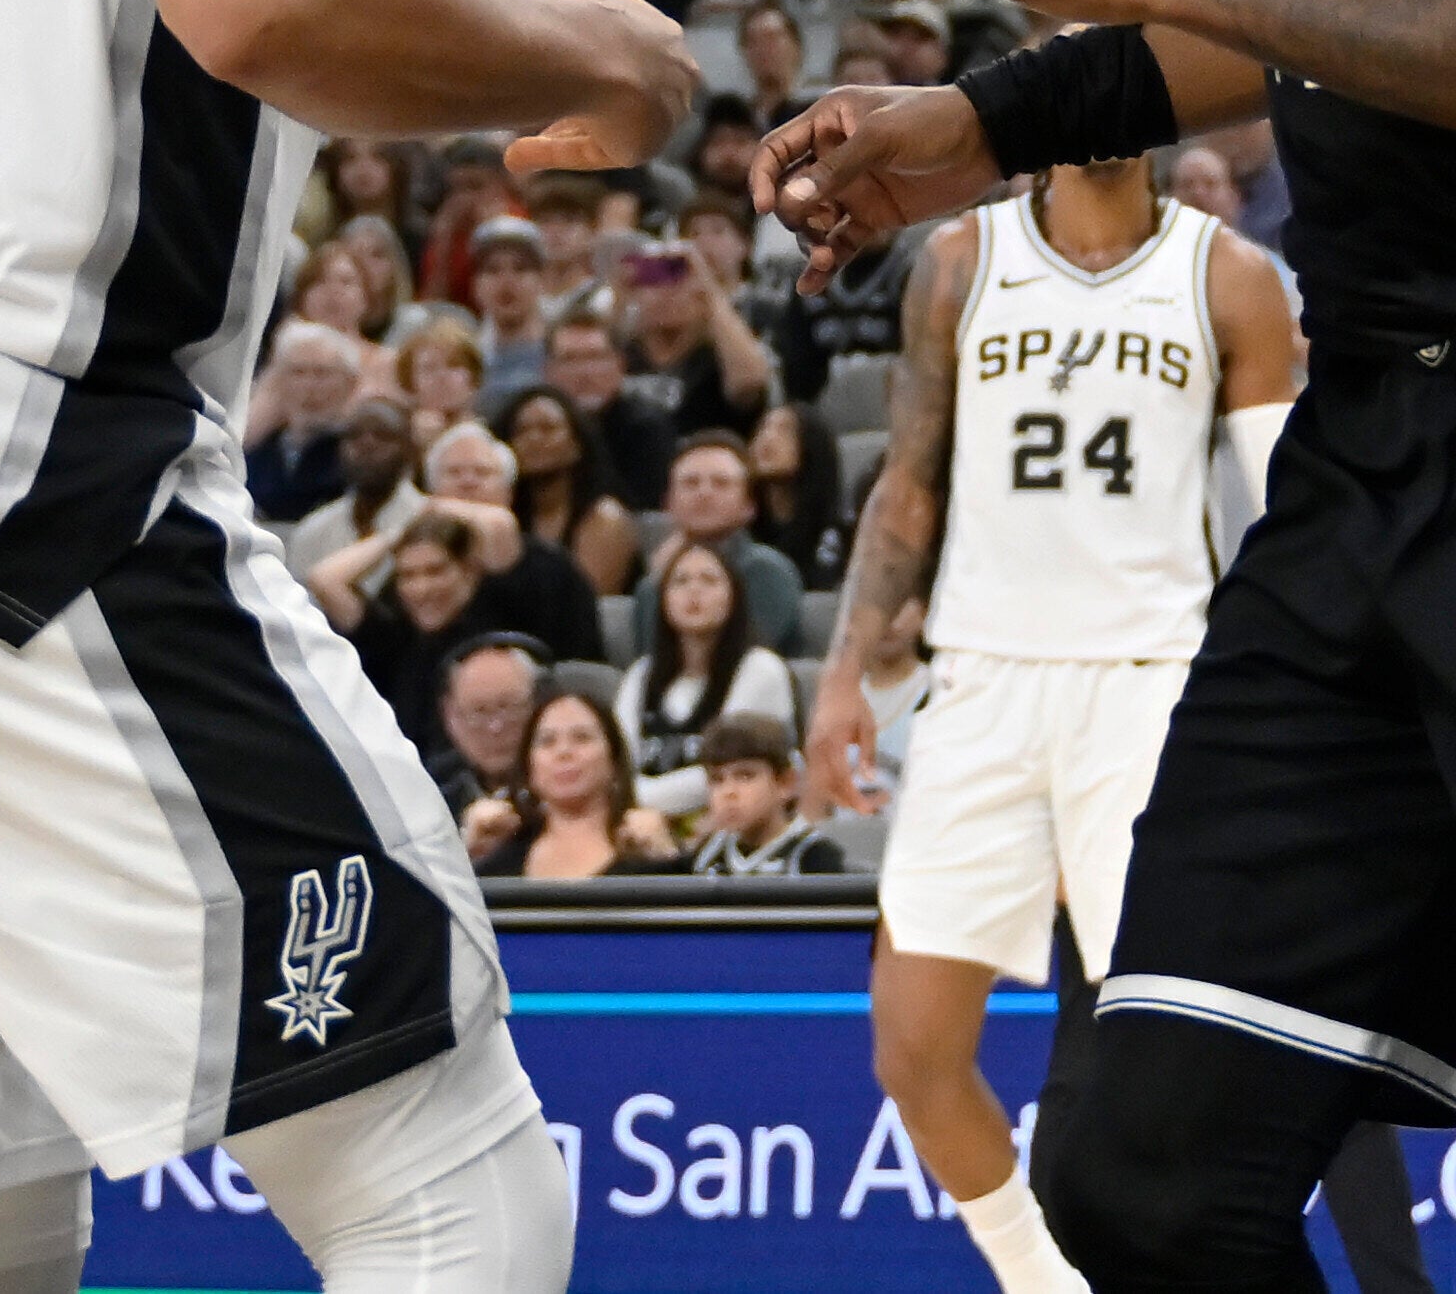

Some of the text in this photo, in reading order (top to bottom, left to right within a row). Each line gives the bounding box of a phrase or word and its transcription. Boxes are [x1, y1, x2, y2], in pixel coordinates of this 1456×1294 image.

[978, 328, 1193, 395] SPURS
[1010, 411, 1135, 497] 24
[607, 1092, 814, 1221] San
